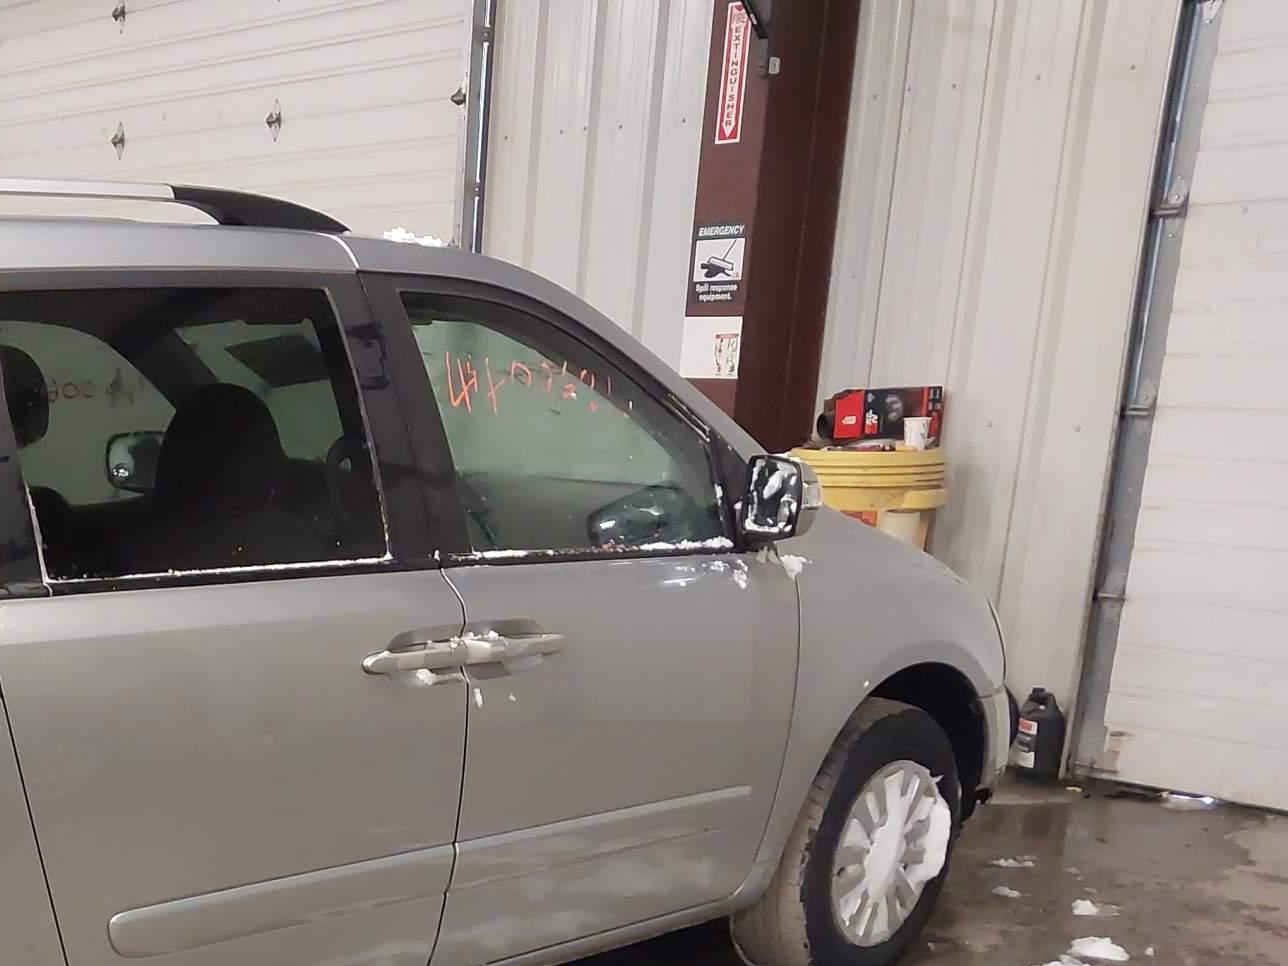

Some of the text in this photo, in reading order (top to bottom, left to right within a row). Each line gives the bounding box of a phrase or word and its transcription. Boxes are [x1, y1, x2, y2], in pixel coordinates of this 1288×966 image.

[725, 26, 741, 127] EXTINGUISHER
[698, 224, 745, 237] EMERGENCY
[695, 283, 738, 293] Spill response
[698, 292, 732, 302] equipment.
